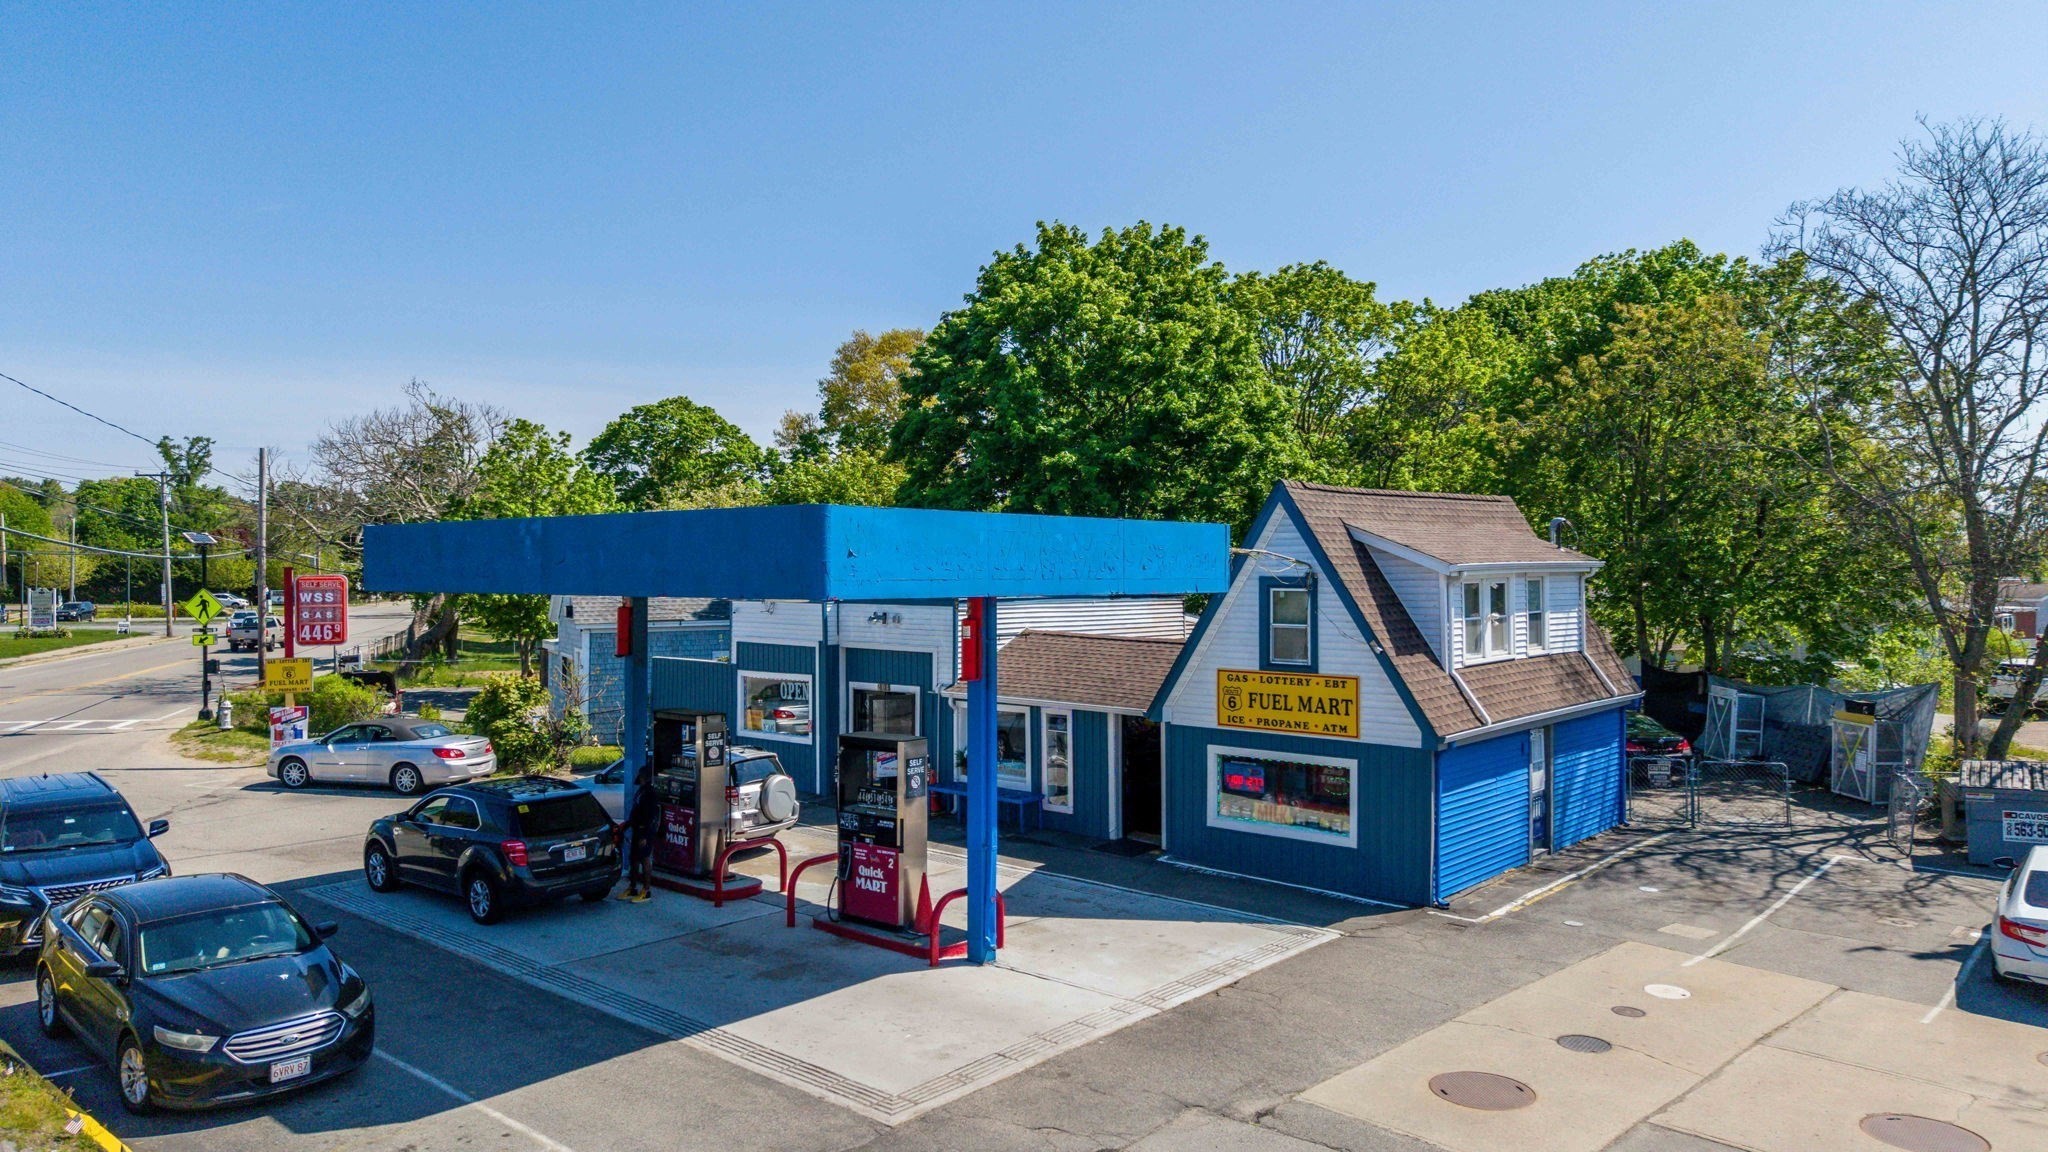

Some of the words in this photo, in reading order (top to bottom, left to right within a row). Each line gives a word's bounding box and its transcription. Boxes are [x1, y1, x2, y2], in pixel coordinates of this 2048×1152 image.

[299, 592, 334, 602] WSS
[301, 625, 333, 640] 446
[1227, 674, 1248, 682] GAS
[1259, 676, 1312, 686] LOTTERY
[1324, 680, 1348, 688] EBT
[780, 681, 809, 700] OPEN
[1227, 696, 1236, 708] 6
[1248, 692, 1293, 711] FUEL
[1297, 695, 1353, 716] MART
[1227, 715, 1245, 724] ICE
[1256, 718, 1310, 730] PROPANE
[1322, 723, 1348, 733] ATM
[707, 732, 722, 740] SELF
[705, 739, 723, 747] SERVE
[909, 758, 922, 767] SELF
[907, 766, 924, 775] SERVE
[668, 822, 687, 835] Quick
[666, 832, 689, 847] MART
[888, 858, 894, 869] 2
[858, 865, 884, 879] Quick
[855, 876, 888, 893] MART
[297, 1062, 308, 1072] 87
